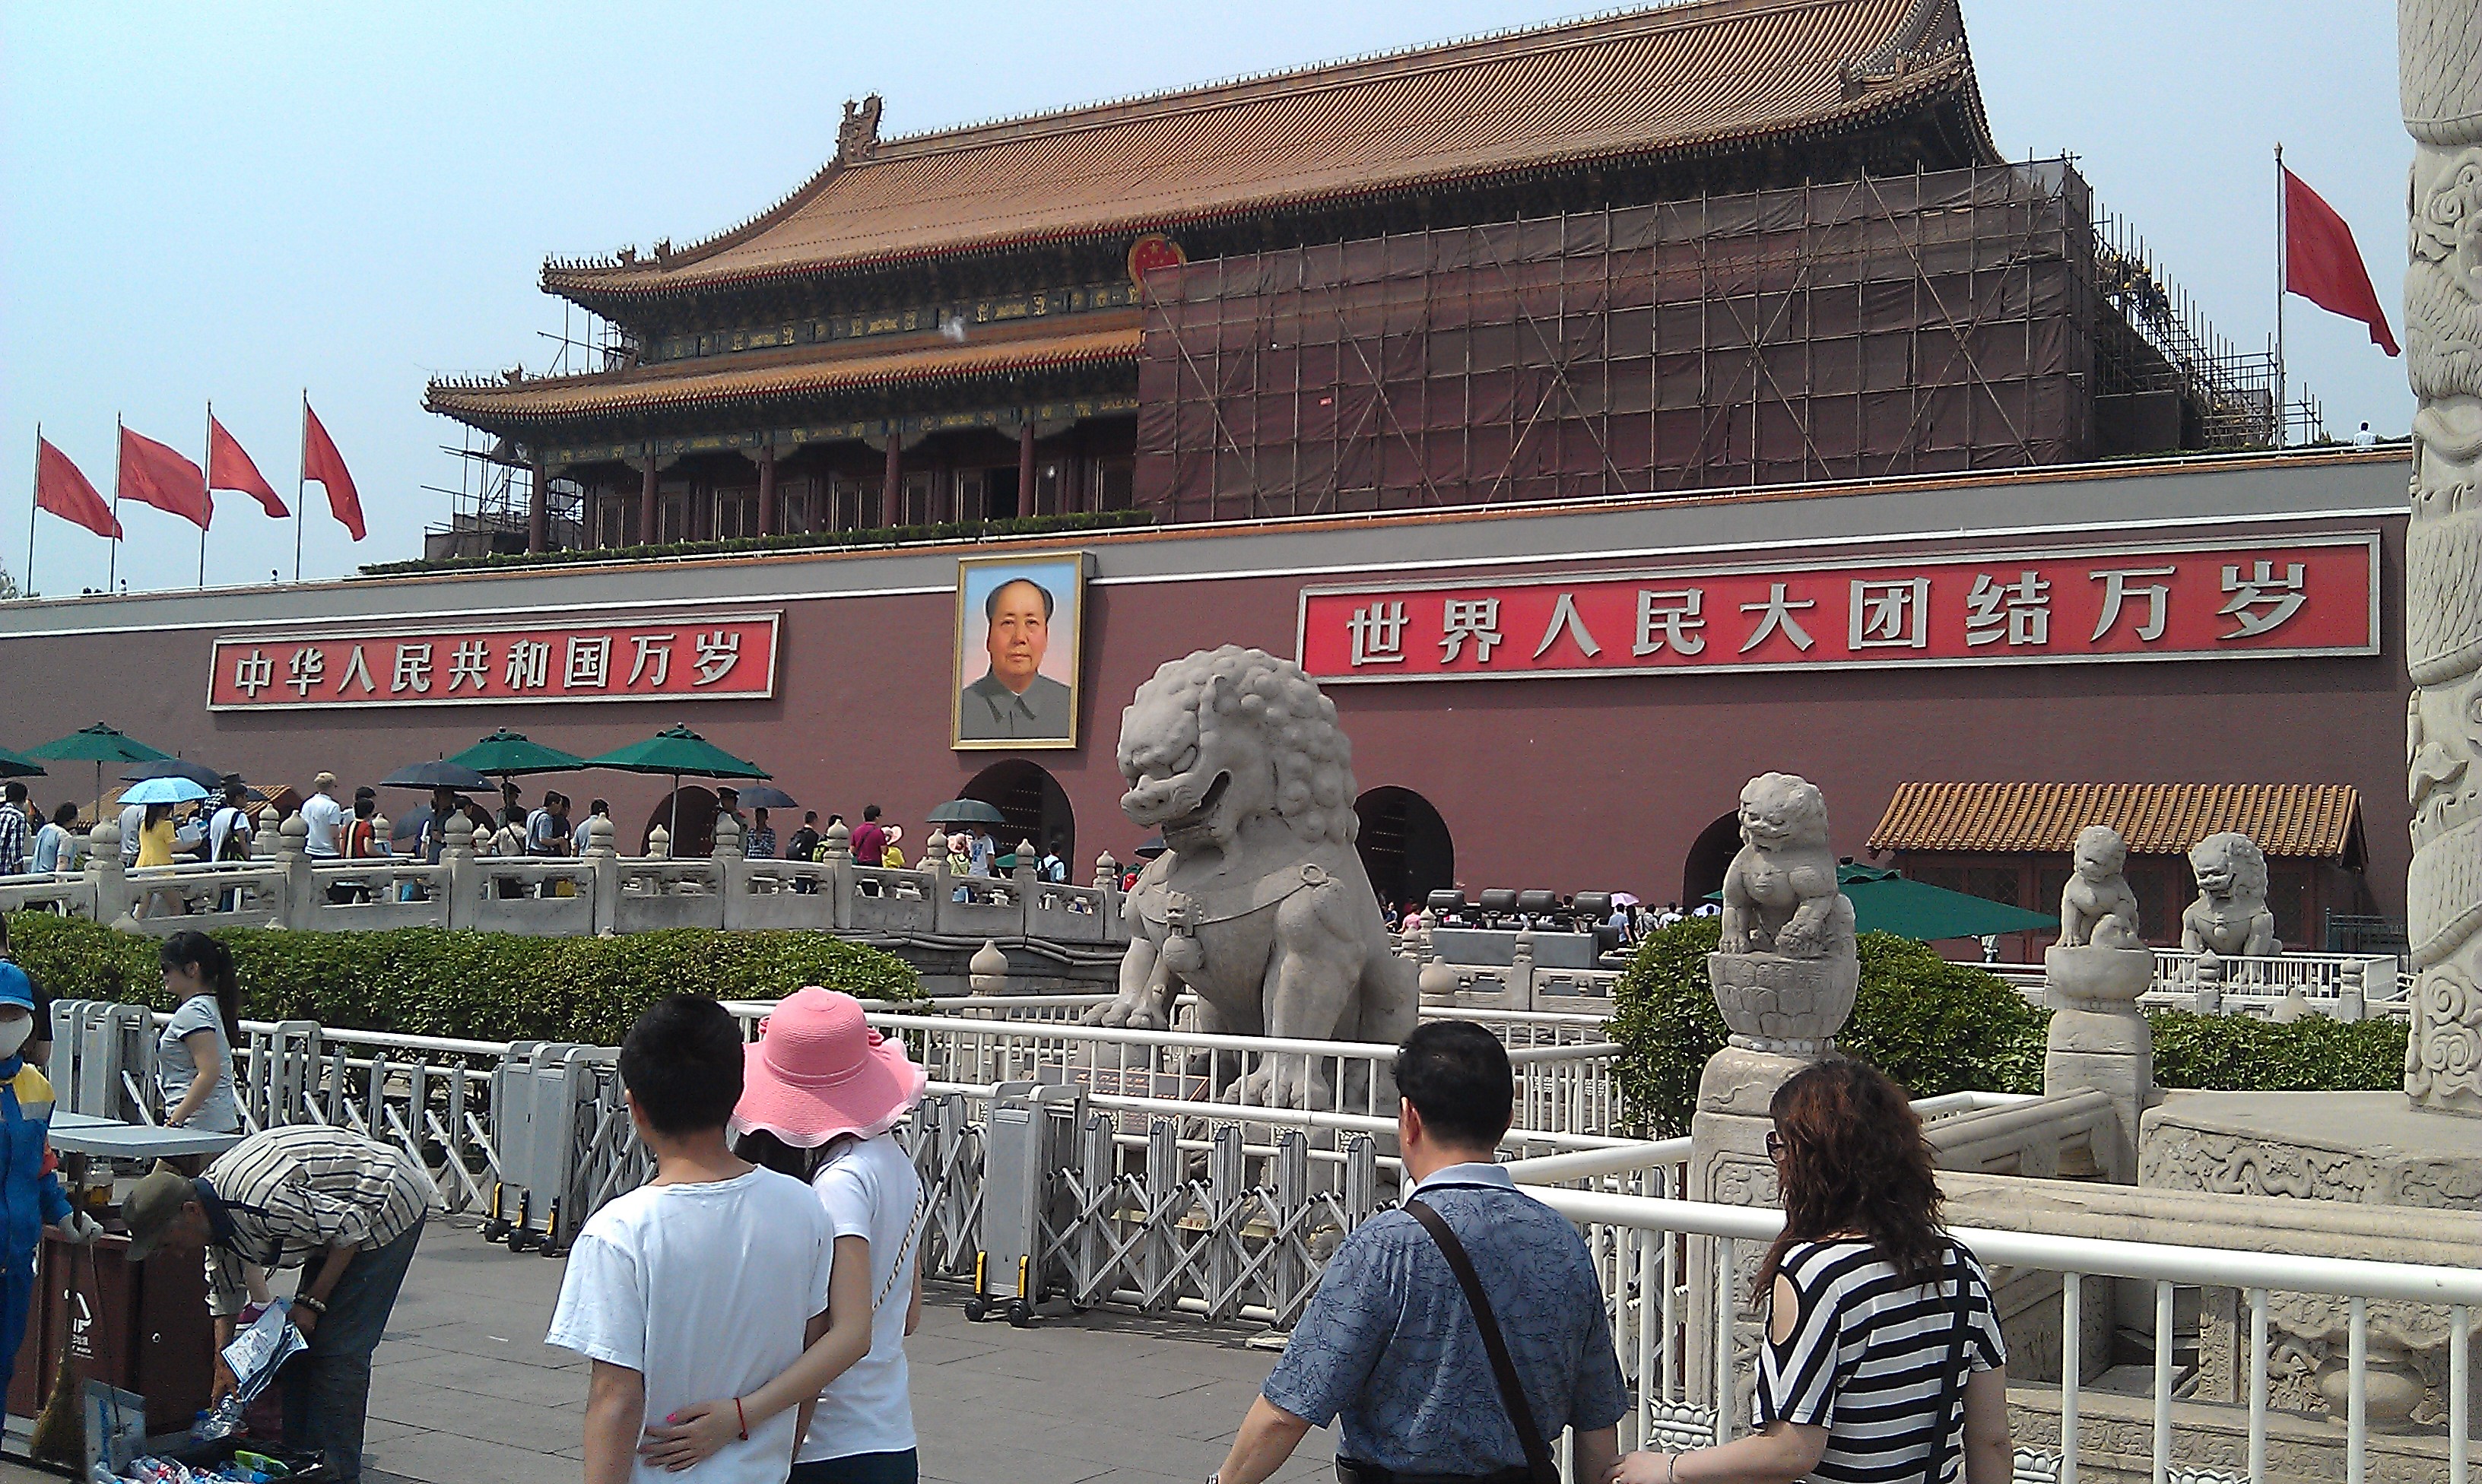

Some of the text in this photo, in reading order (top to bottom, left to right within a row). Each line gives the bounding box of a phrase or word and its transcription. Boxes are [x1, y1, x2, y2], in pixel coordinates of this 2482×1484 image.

[1346, 560, 2308, 667] 世界人民大团结万岁
[235, 630, 741, 697] 中华人民共和国万岁
